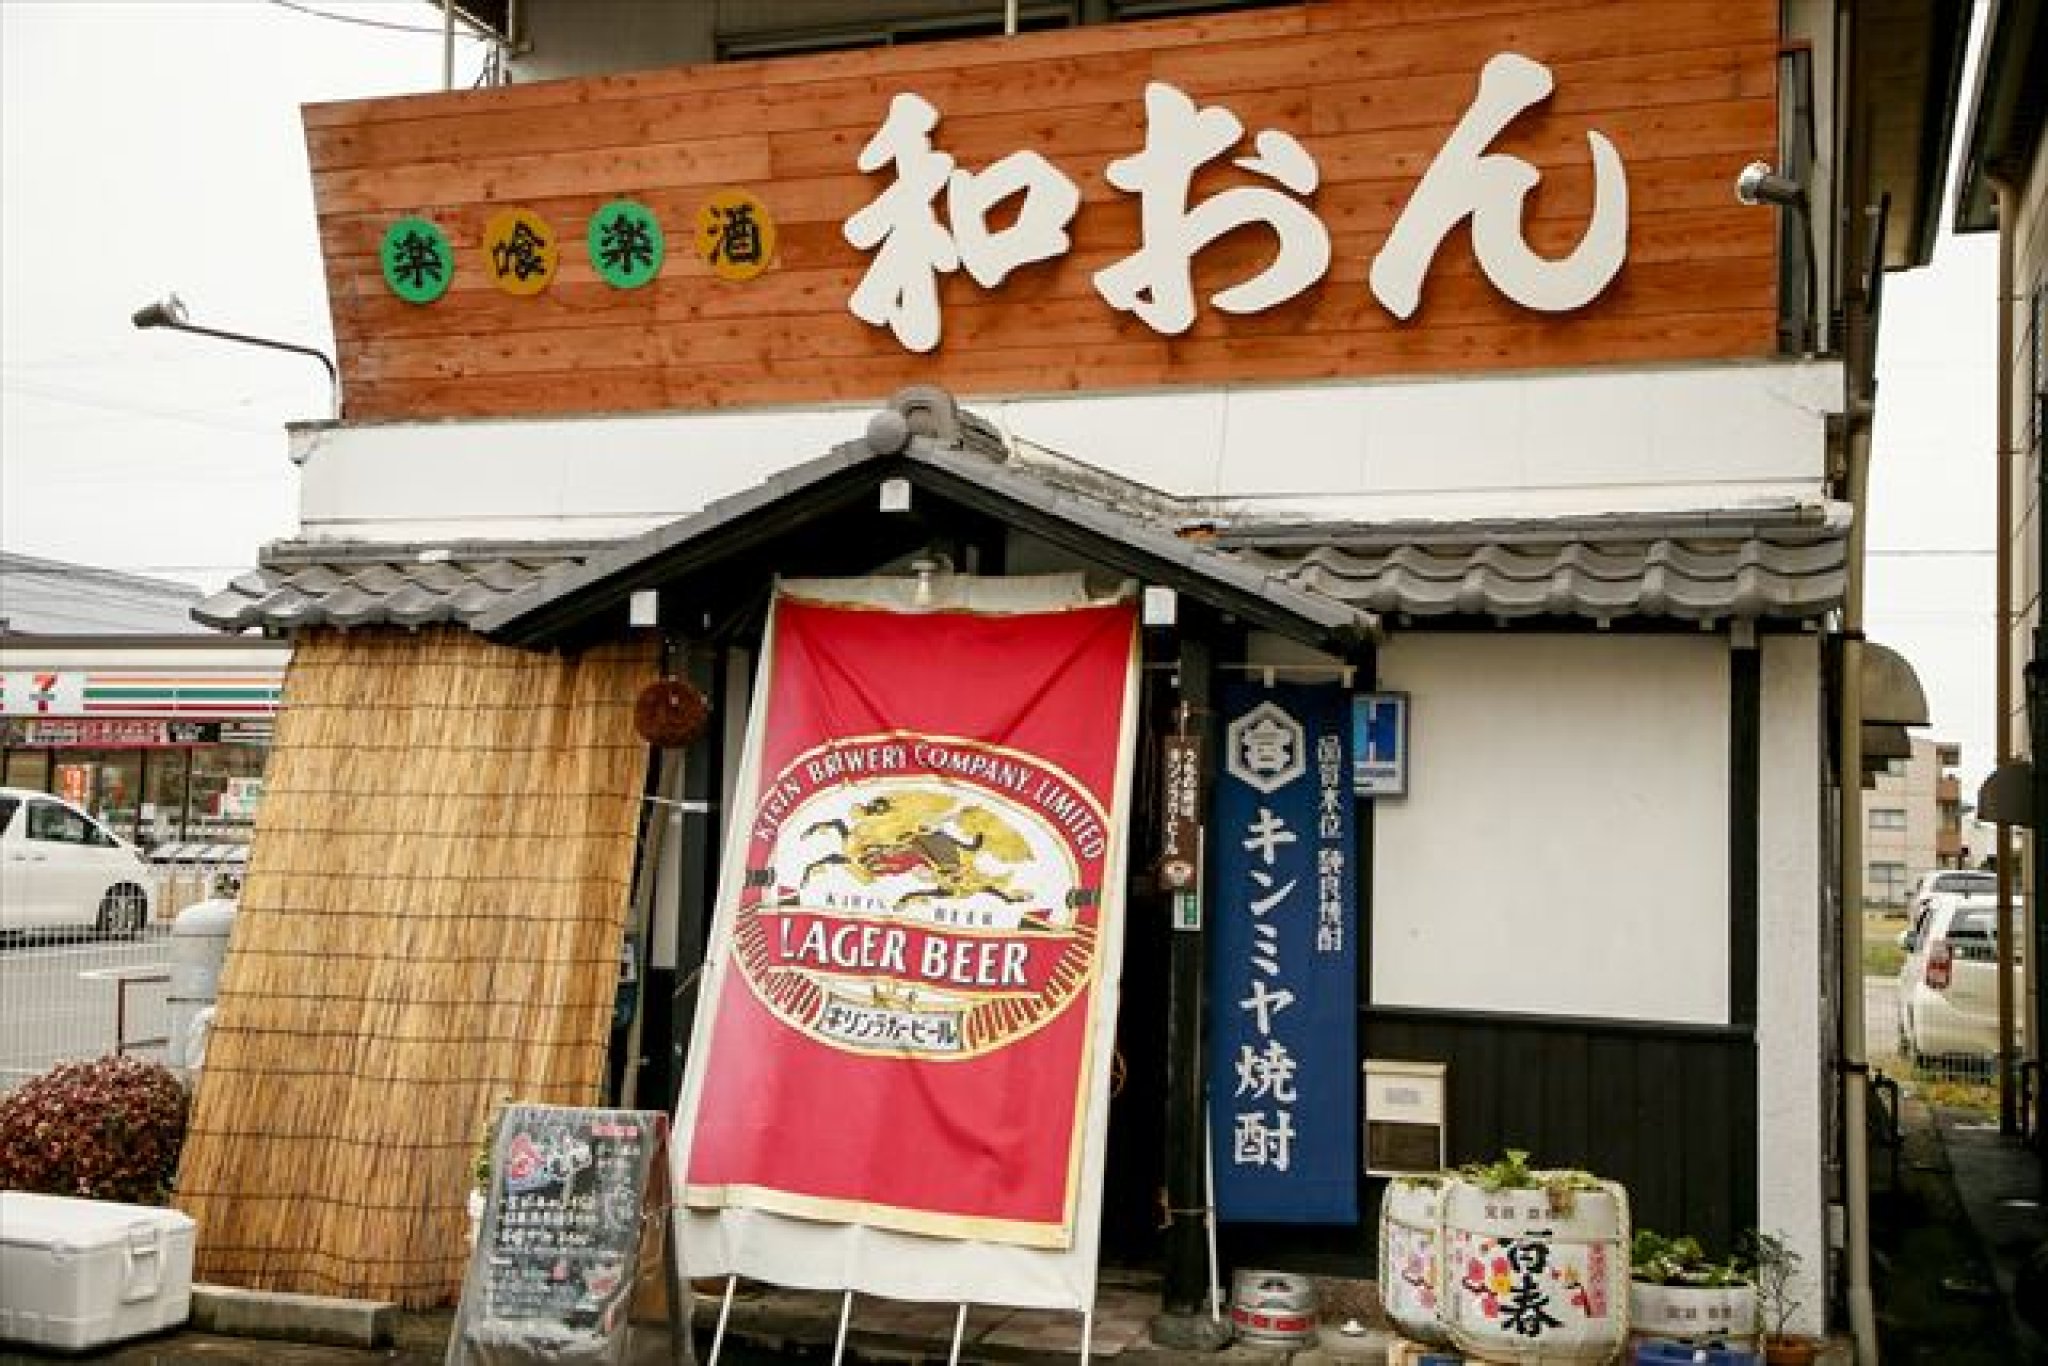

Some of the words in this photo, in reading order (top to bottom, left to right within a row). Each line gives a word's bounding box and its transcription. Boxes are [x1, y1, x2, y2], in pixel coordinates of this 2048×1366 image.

[844, 52, 1628, 353] 和おん
[1033, 778, 1105, 859] LIMITED
[779, 916, 908, 973] LAGER
[920, 936, 1030, 986] BEER
[1234, 807, 1298, 1173] キンミヤ焼酎
